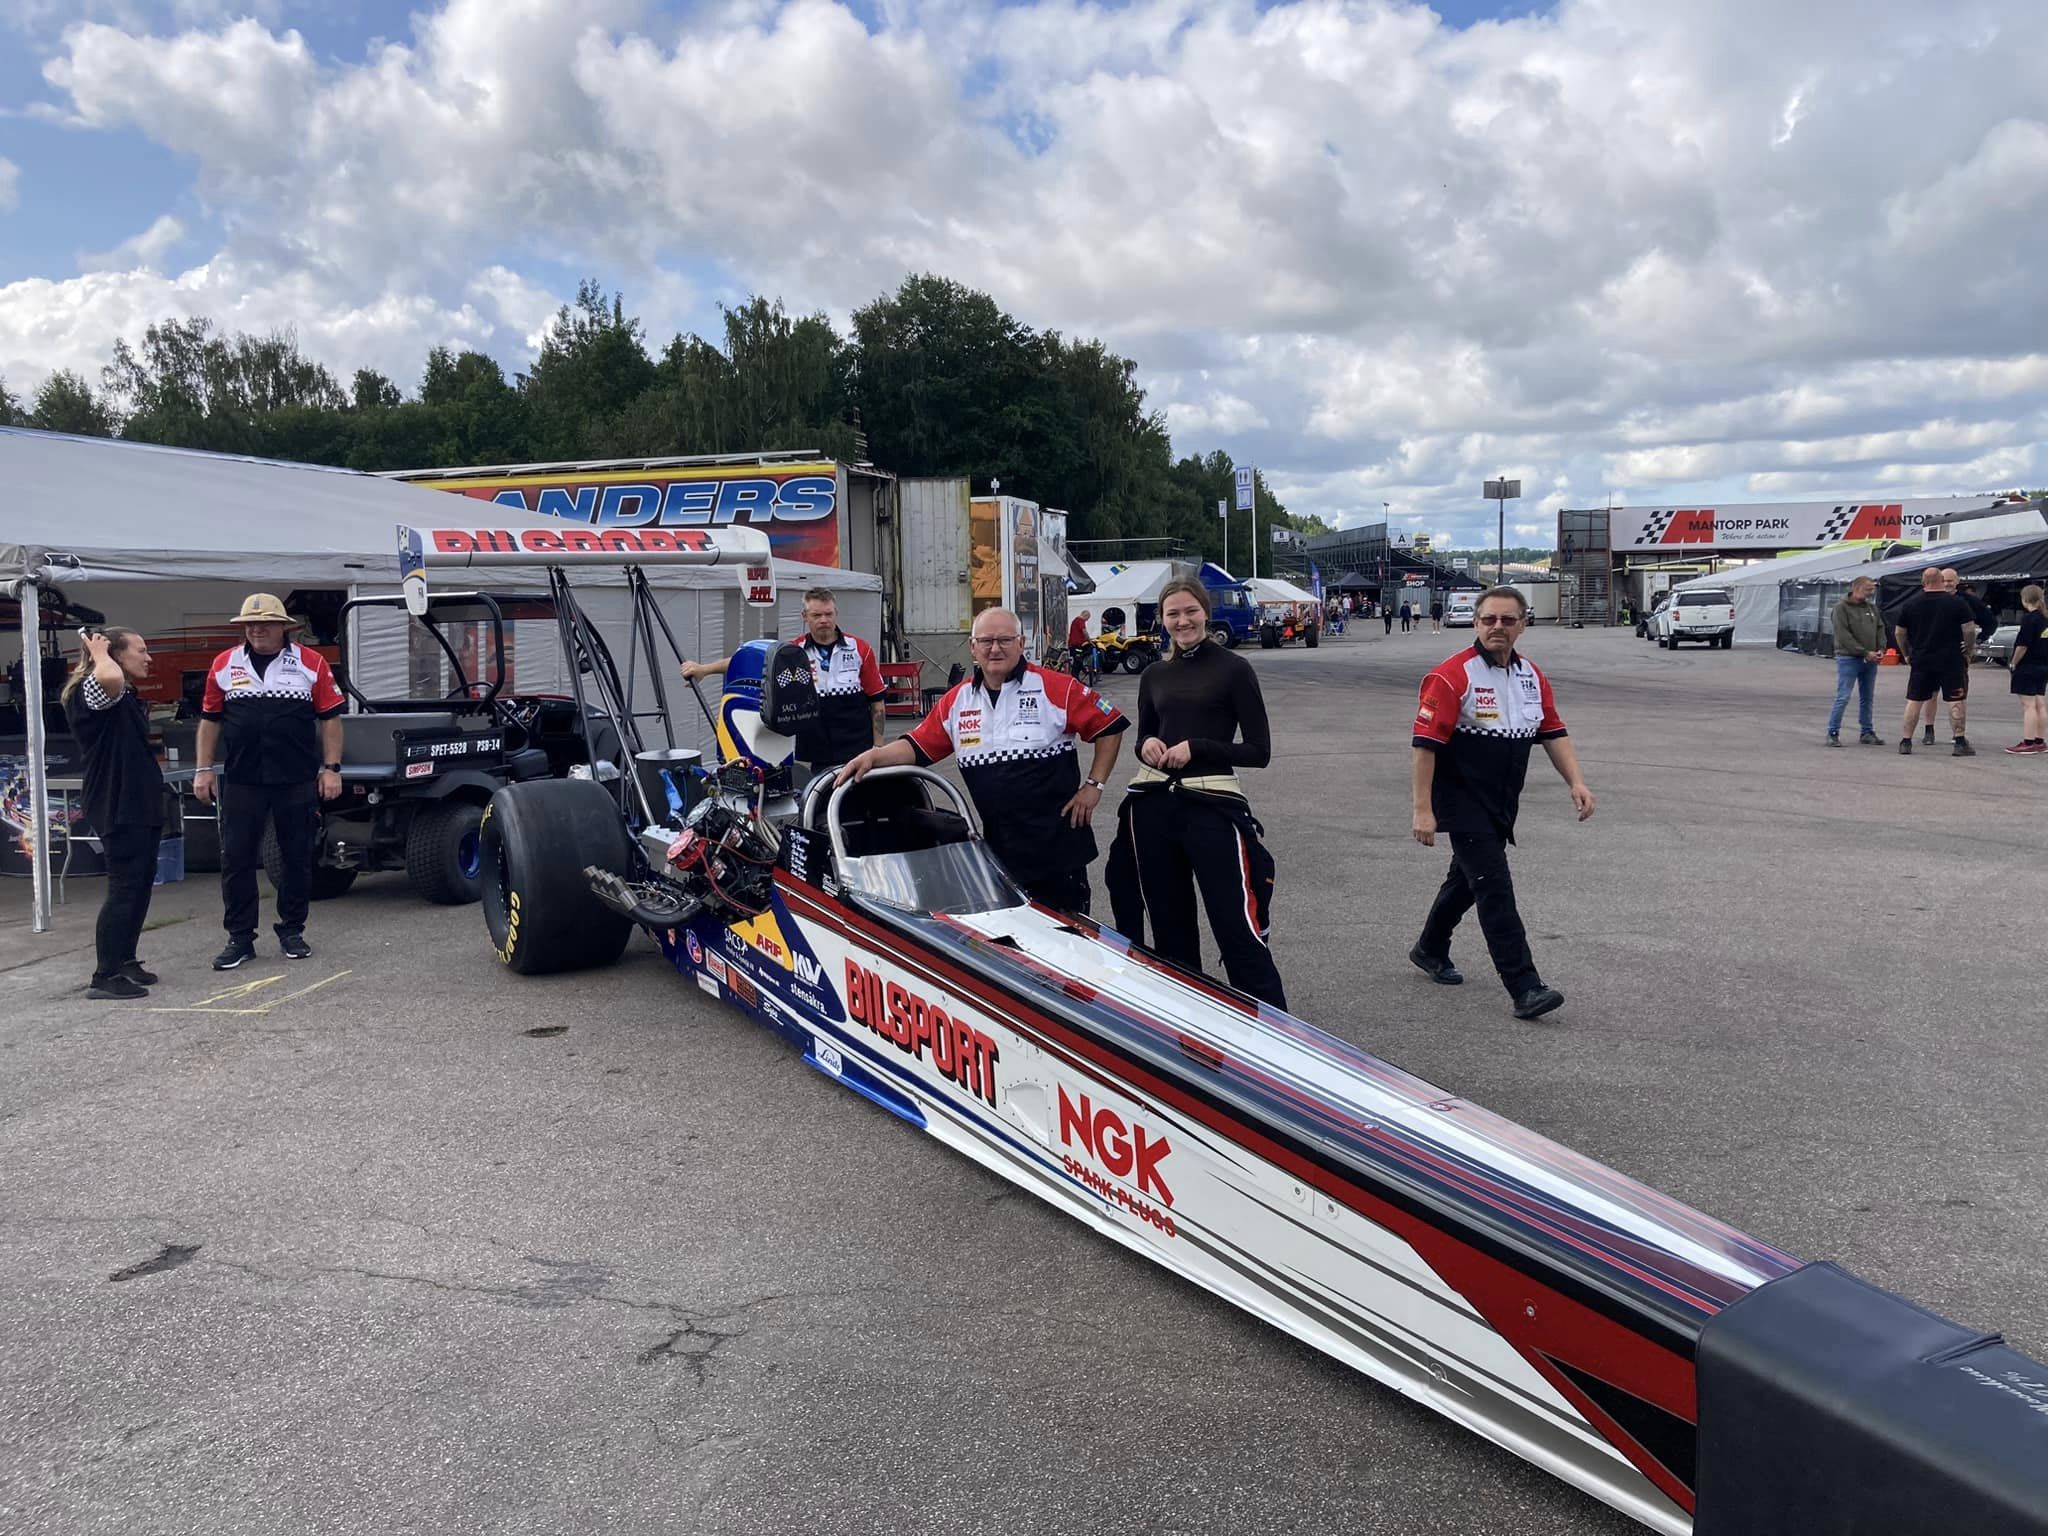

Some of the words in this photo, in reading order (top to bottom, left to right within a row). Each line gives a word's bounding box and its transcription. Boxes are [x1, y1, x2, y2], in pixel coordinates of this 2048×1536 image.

[1688, 519, 1752, 531] MANTORP
[1756, 518, 1789, 530] PARK
[1398, 534, 1406, 543] A
[1476, 696, 1496, 705] NGK
[958, 719, 981, 731] NGK
[408, 763, 432, 776] SIMPSON
[755, 933, 782, 958] ARP
[844, 957, 999, 1109] BILSPORT
[820, 1049, 841, 1071] Linde
[1057, 1081, 1174, 1208] NGK
[1063, 1154, 1113, 1201] SPARK
[1117, 1190, 1176, 1237] PLUGS
